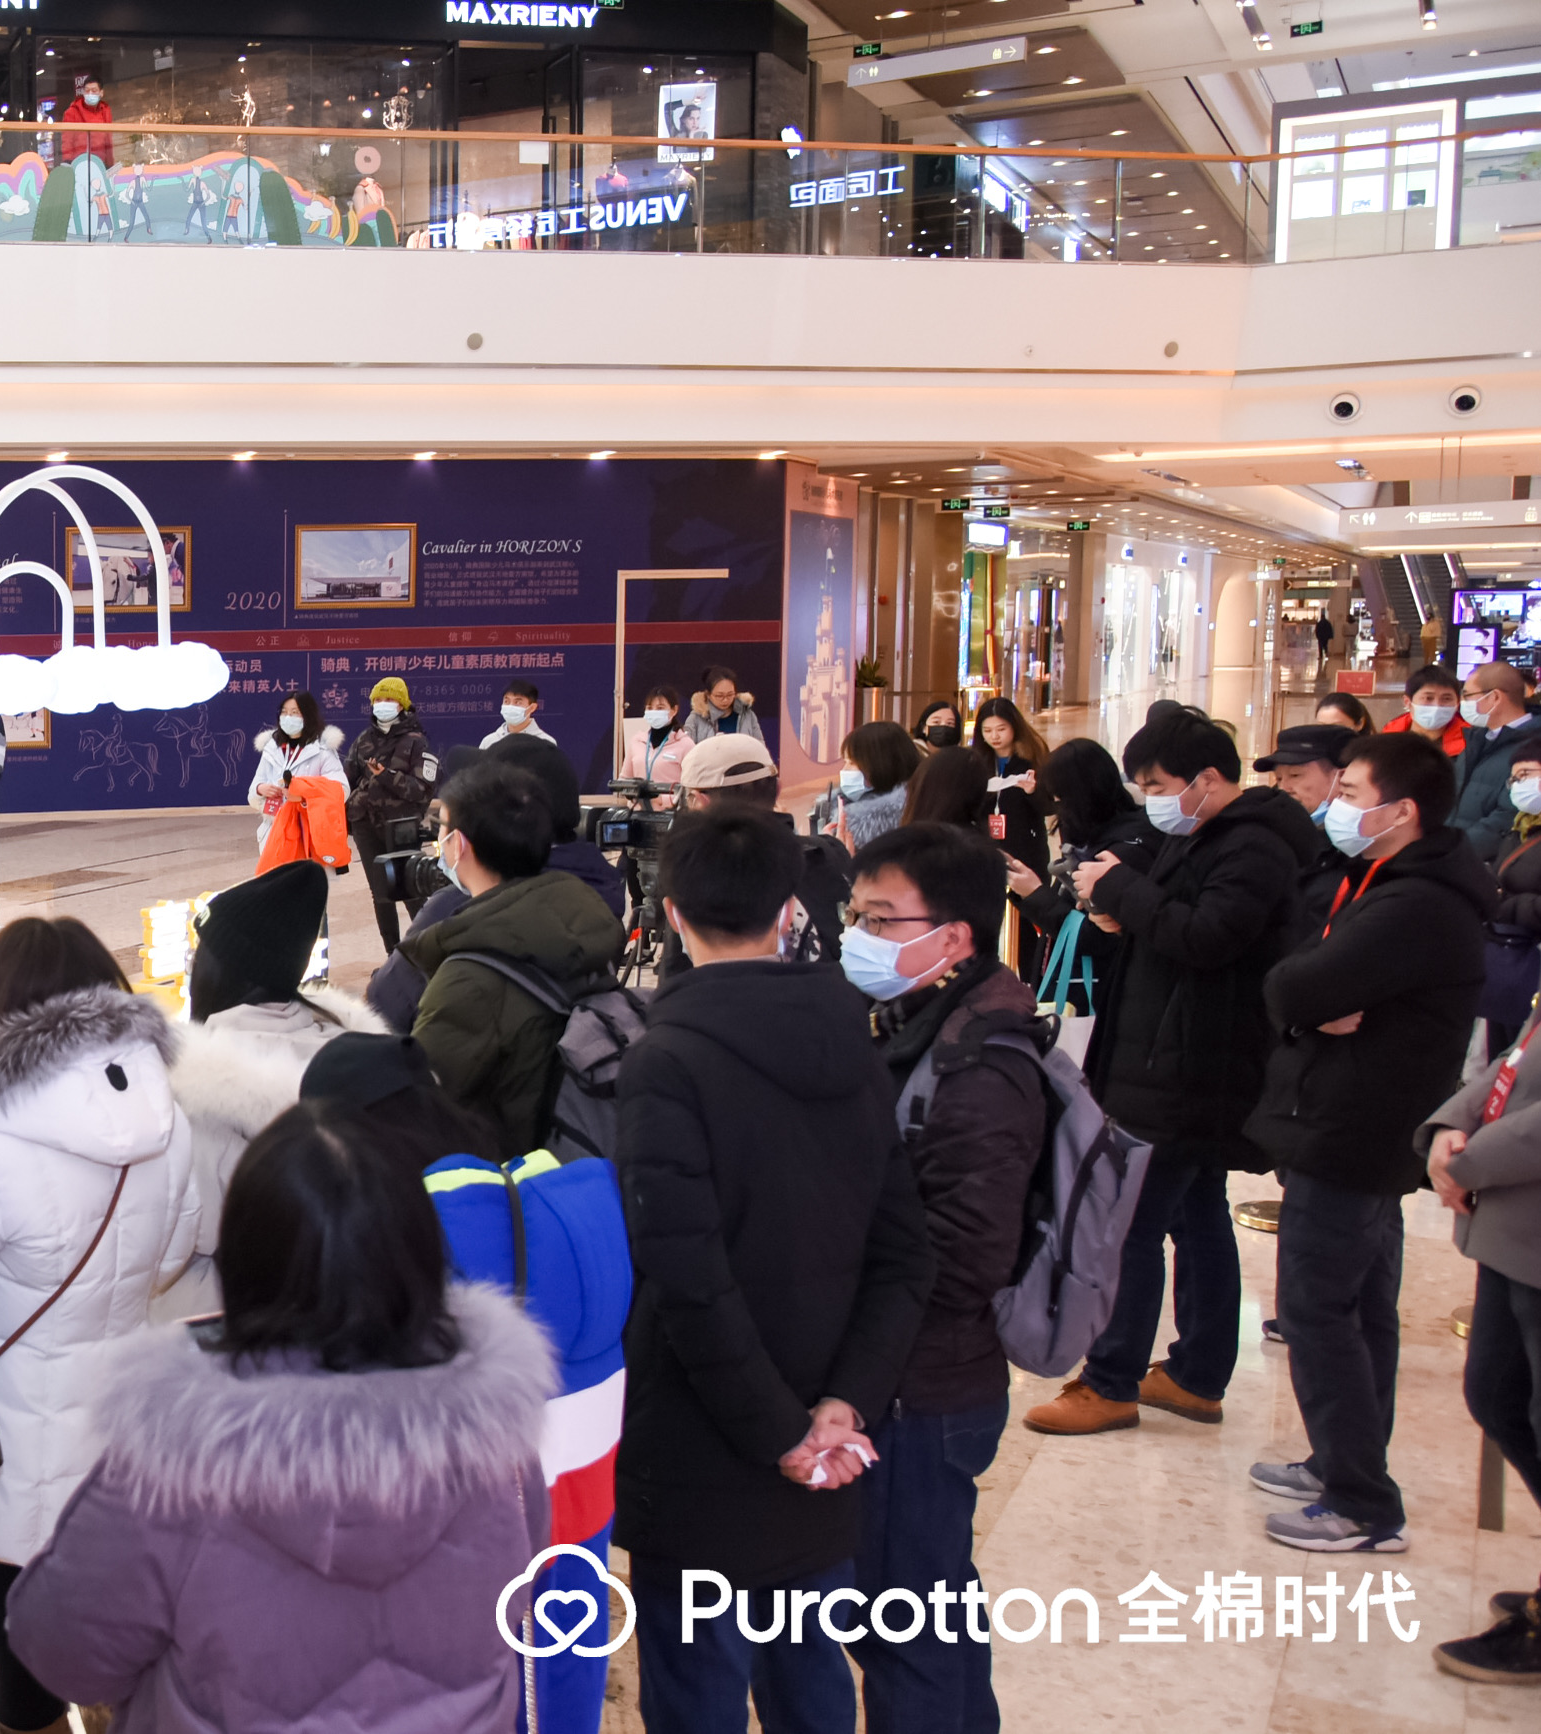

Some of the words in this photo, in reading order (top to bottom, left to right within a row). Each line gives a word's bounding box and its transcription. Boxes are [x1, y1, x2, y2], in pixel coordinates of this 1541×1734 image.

[445, 1, 599, 29] MAXRIENY
[422, 539, 475, 556] Cavalier
[479, 540, 493, 554] in
[224, 590, 282, 612] 2020
[256, 635, 280, 647] 公正
[325, 634, 360, 645] Justice
[448, 631, 472, 643] 信仰
[515, 630, 571, 643] Spirituality
[461, 684, 492, 695] 0006
